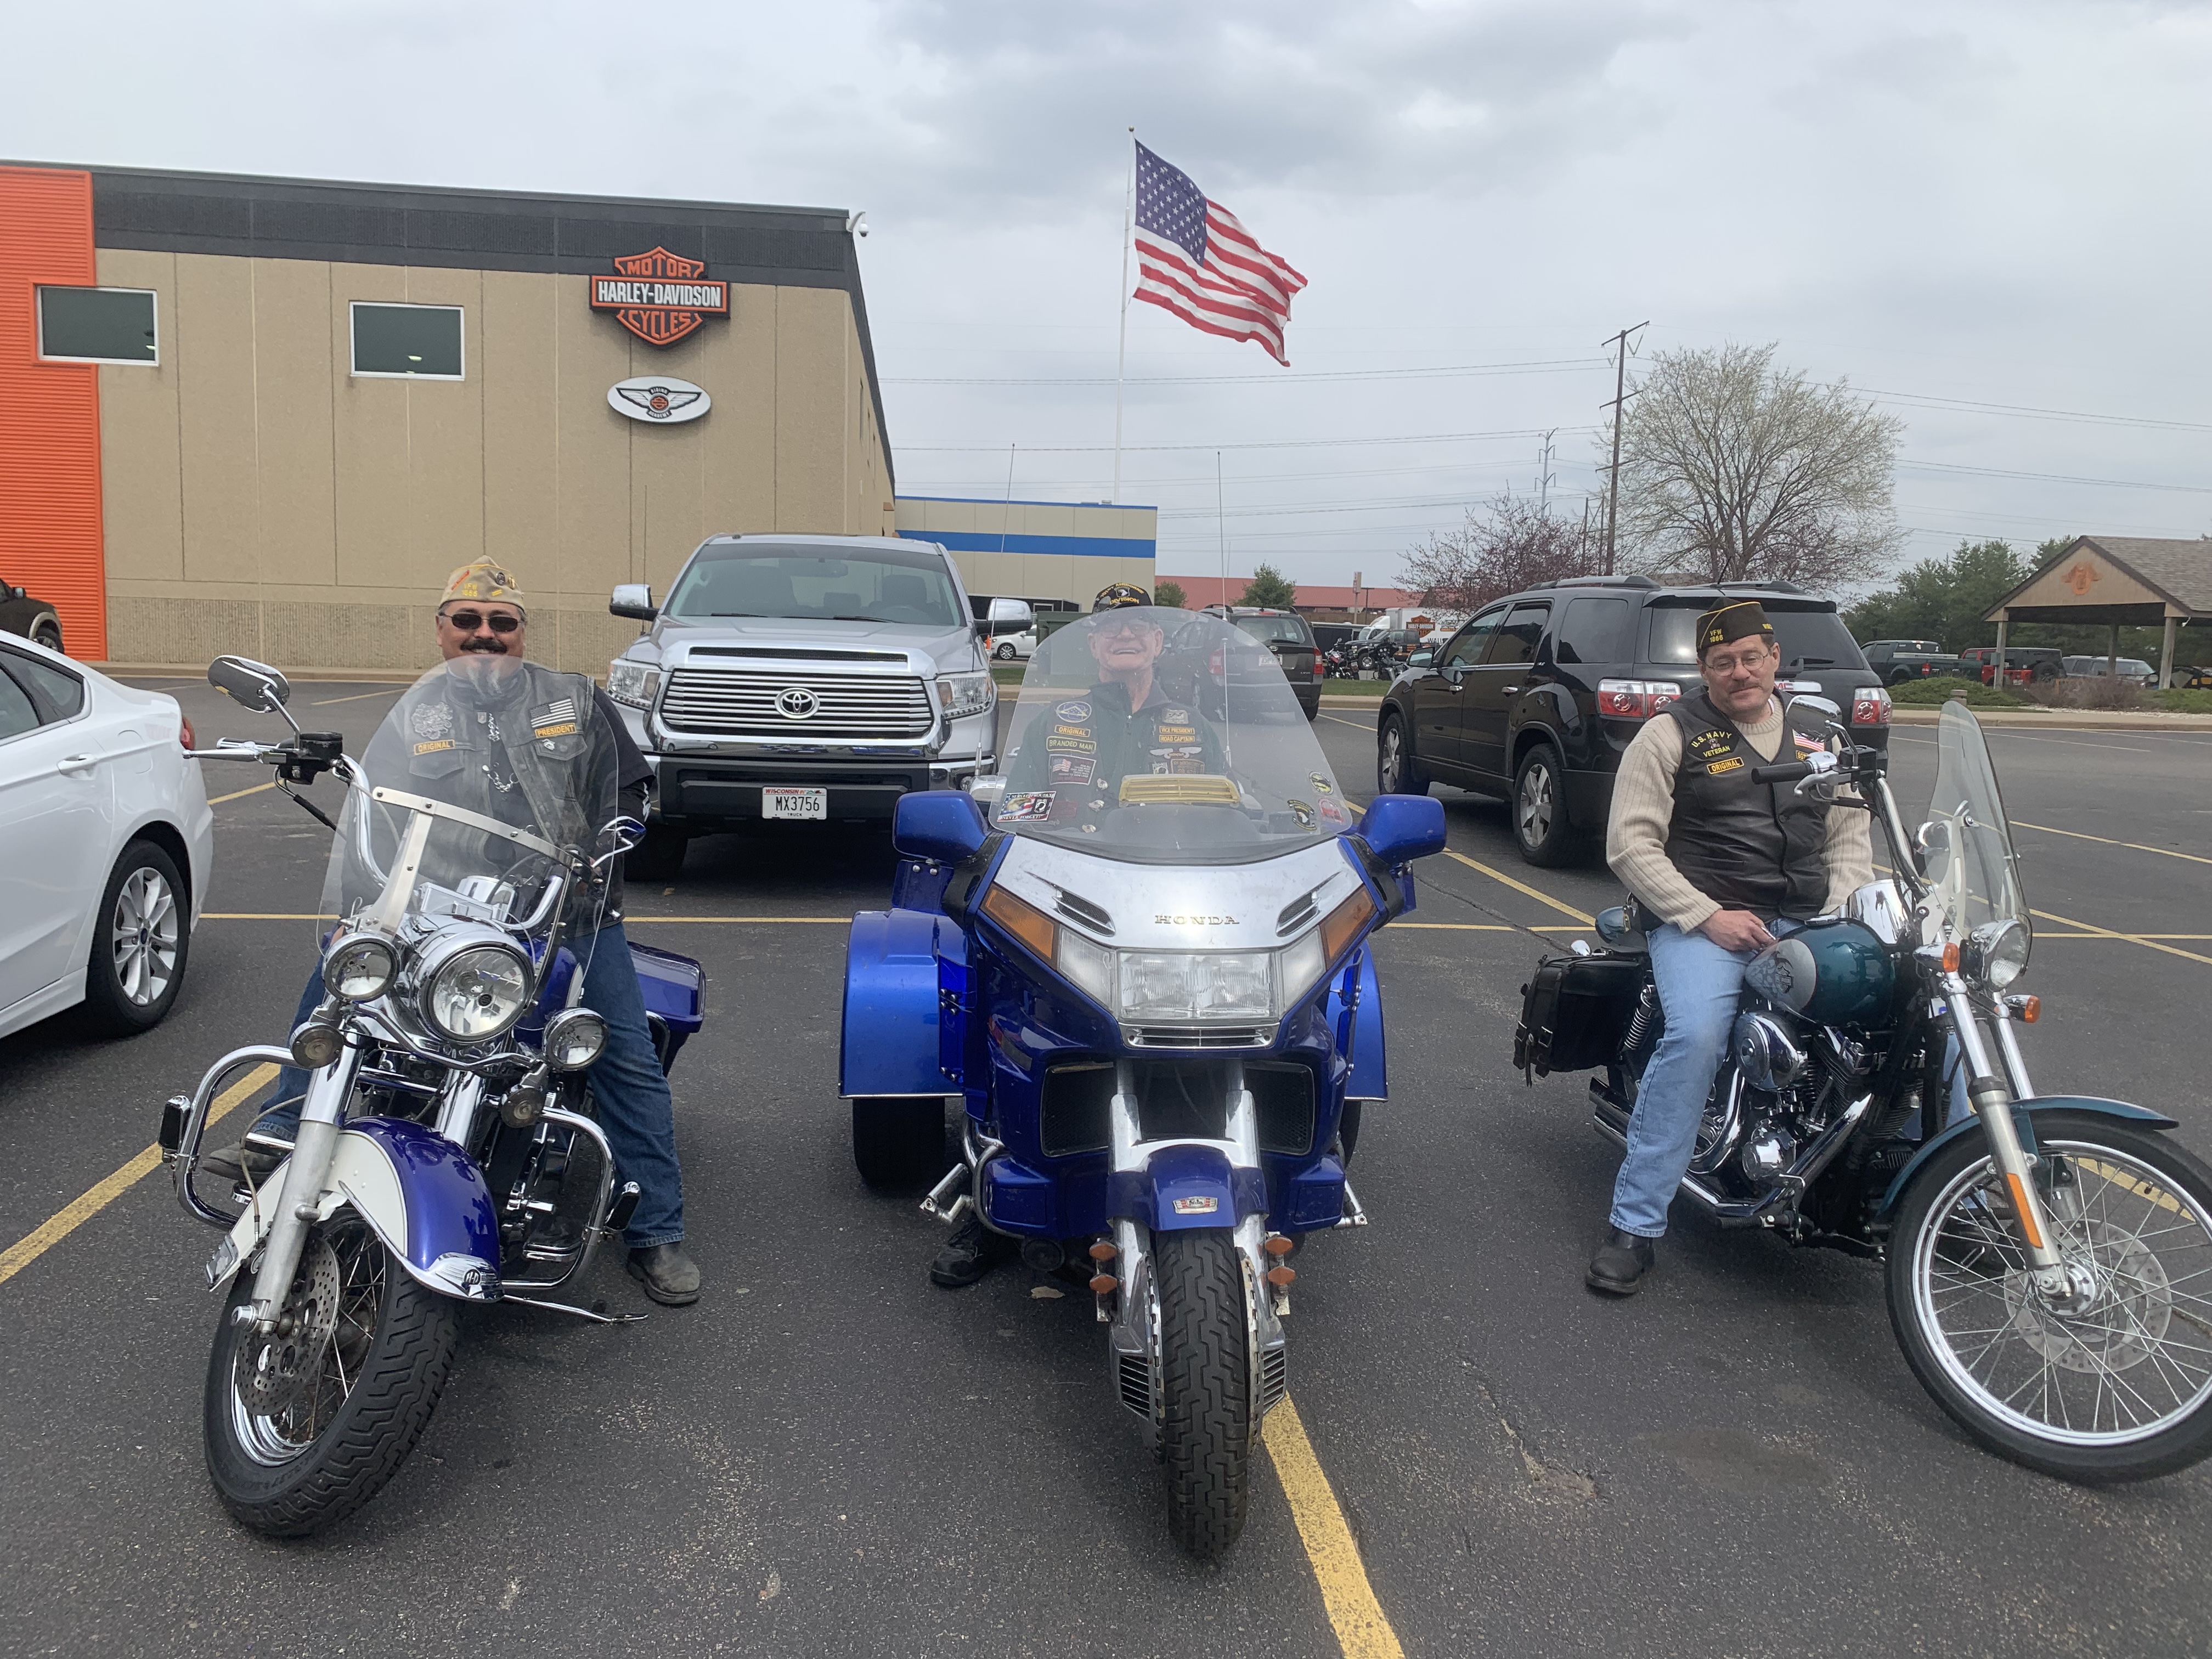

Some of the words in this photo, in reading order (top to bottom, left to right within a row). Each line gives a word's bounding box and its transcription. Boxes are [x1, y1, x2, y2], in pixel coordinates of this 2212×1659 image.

[627, 253, 692, 278] MOTOR
[598, 281, 721, 307] HARLEY-DAVIDSON
[628, 310, 691, 338] CYCLES
[1115, 583, 1144, 594] AIRBORNE
[1109, 597, 1139, 605] DIVISION
[537, 724, 574, 737] PRESIDENT
[1058, 726, 1086, 736] ORIGINAL
[1691, 736, 1706, 748] U.S.
[1706, 731, 1732, 739] NAVY
[418, 742, 450, 753] ORIGINAL
[1702, 745, 1730, 757] VETERAN
[1711, 759, 1740, 772] ORIGINAL
[776, 796, 820, 811] MX3756
[1155, 915, 1240, 925] HONDA
[465, 1271, 479, 1284] H-D
